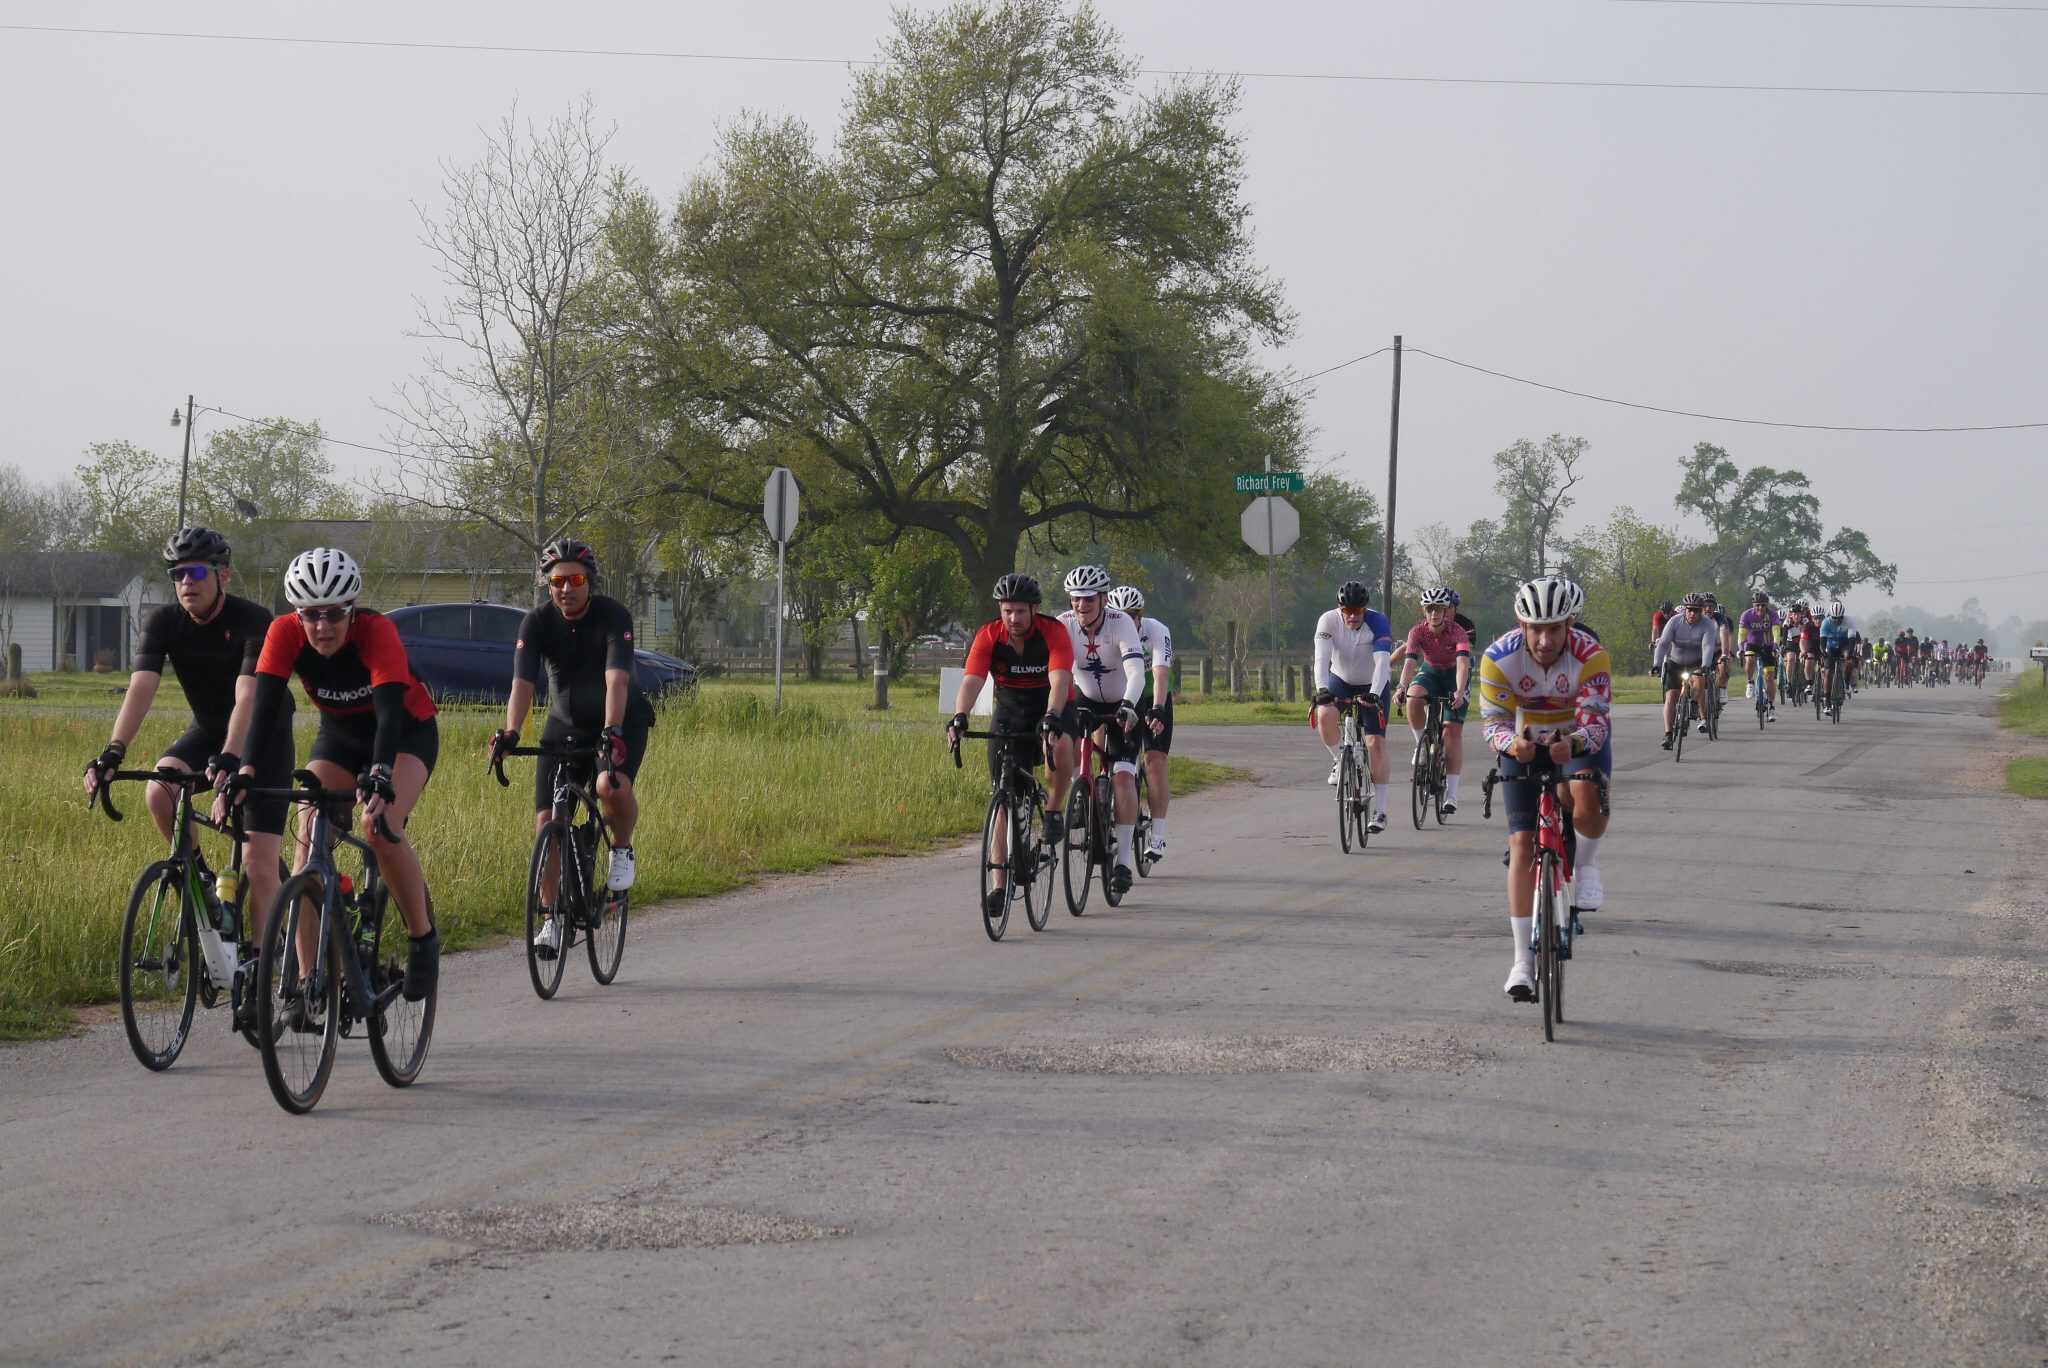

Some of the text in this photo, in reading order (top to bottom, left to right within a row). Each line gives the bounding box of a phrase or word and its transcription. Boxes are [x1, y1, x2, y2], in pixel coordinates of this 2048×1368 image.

[1236, 475, 1269, 491] Richard
[1272, 475, 1290, 491] Frey
[1010, 665, 1048, 674] ELLWOO
